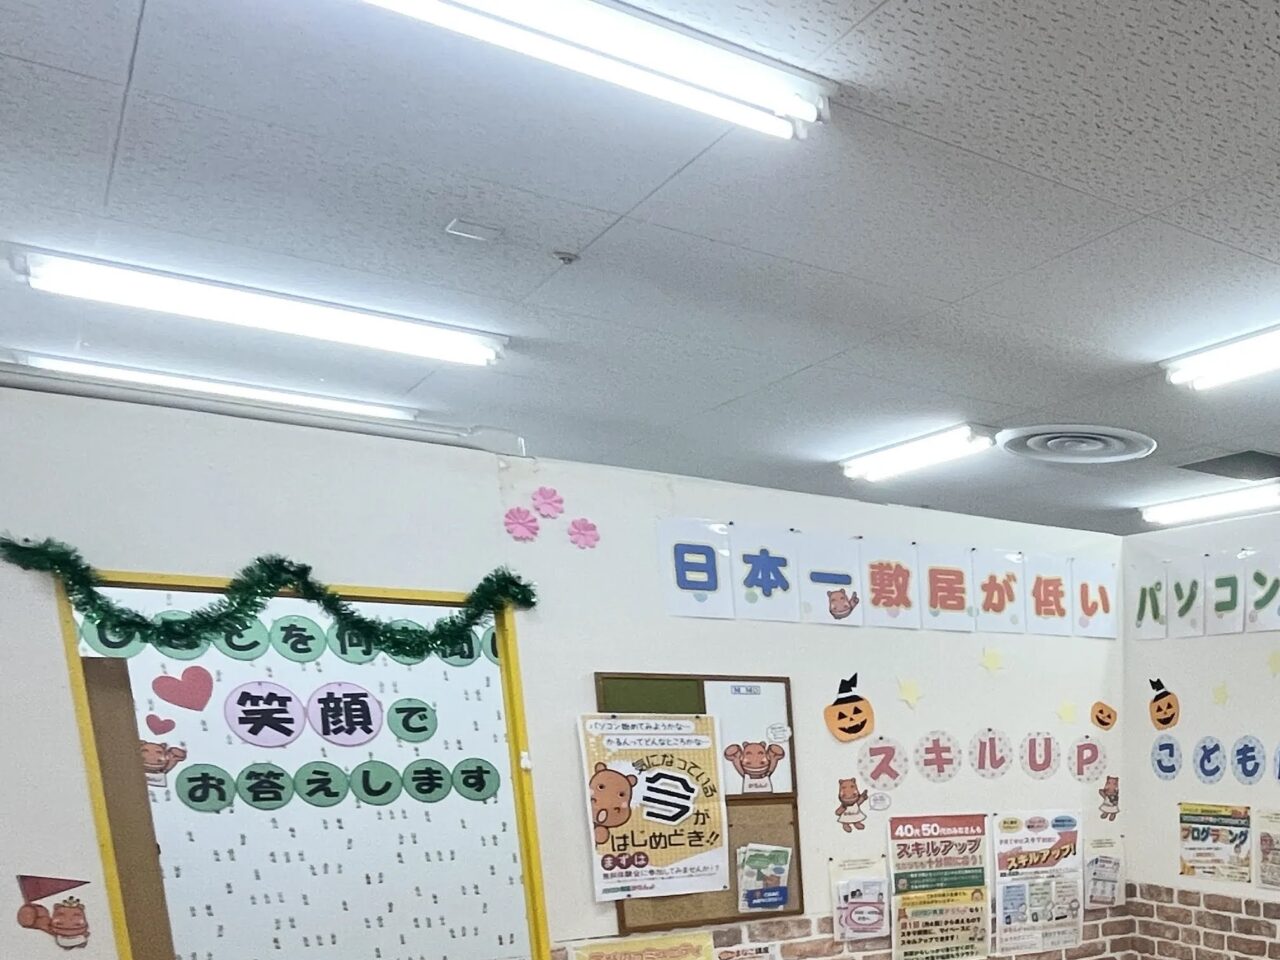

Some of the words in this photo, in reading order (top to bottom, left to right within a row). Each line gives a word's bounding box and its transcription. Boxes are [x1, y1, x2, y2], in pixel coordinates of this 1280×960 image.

[673, 542, 1111, 619] 日本一敷居が低い
[237, 691, 430, 737] 笑顔で
[632, 753, 717, 798] 気になっている
[869, 737, 1100, 781] スキルUP
[186, 764, 492, 804] お答えします
[896, 838, 982, 859] スキルアップ
[1180, 825, 1249, 846] プログラミング
[603, 853, 647, 868] まずは
